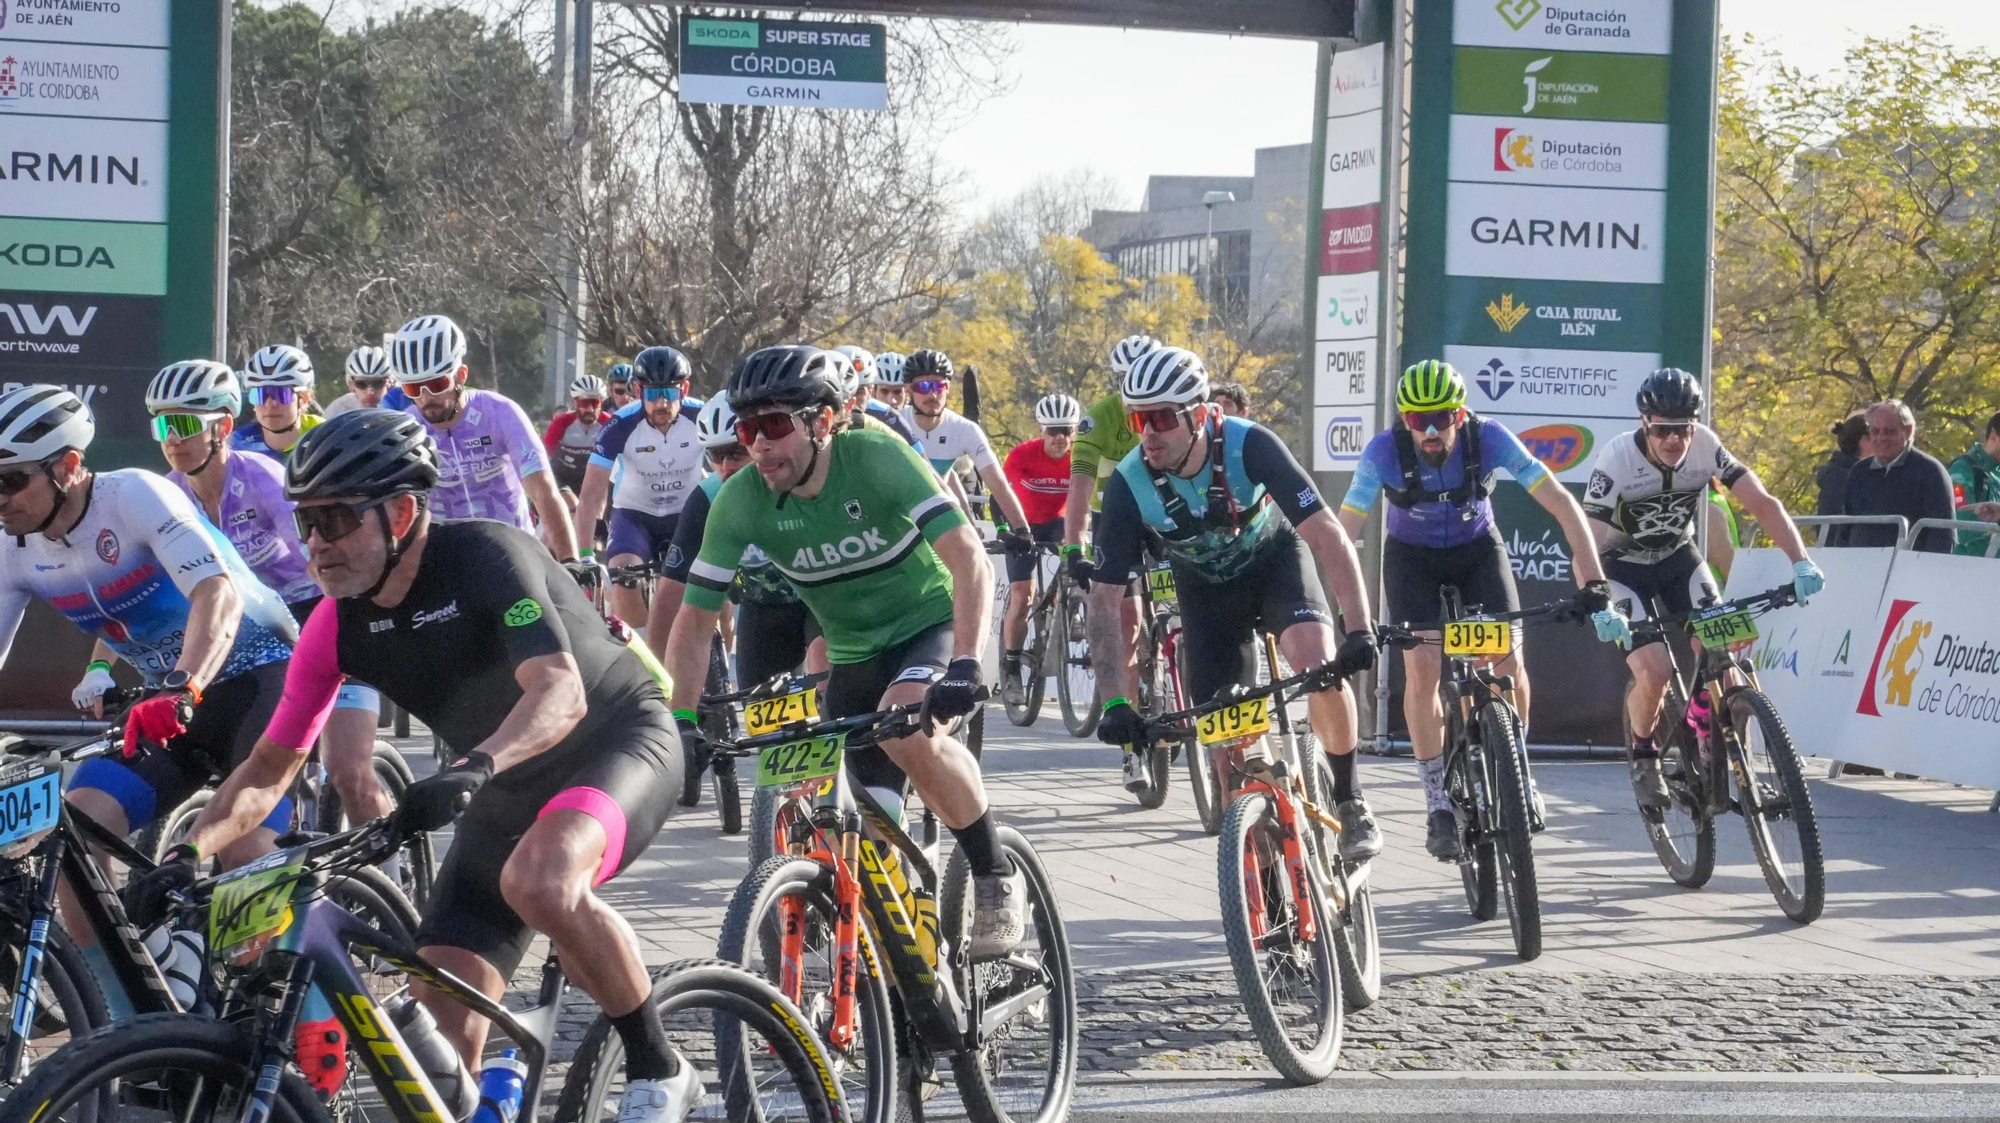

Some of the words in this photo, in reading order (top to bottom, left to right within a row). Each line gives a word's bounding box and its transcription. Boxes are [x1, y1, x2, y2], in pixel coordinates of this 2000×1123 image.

[17, 0, 120, 13] AYUNTAMIENTO
[1546, 7, 1626, 23] Diputación
[16, 13, 34, 24] DE
[38, 13, 73, 26] JAÉN
[766, 29, 817, 44] SUPER
[821, 33, 871, 47] STAGE
[1545, 23, 1562, 35] de
[1565, 23, 1631, 38] Granada
[21, 61, 119, 80] AYUNTAMIENTO
[731, 52, 836, 76] CÓRDOBA
[20, 82, 34, 97] DE
[39, 83, 99, 100] CORDOBA
[747, 85, 820, 100] GARMIN
[1538, 82, 1598, 93] DIPUTACIÓN
[1538, 94, 1550, 102] DE
[1552, 93, 1577, 104] JAÉN
[1542, 140, 1622, 157] Diputación
[0, 151, 138, 186] RMIN
[1330, 149, 1375, 172] GARMIN
[1541, 159, 1558, 169] de
[1563, 158, 1622, 173] Córdoba
[1344, 224, 1372, 245] IMDECO
[1471, 216, 1640, 250] GARMIN
[1536, 306, 1570, 319] CAJA
[1573, 307, 1621, 321] RURAL
[1561, 322, 1595, 336] JAÉN
[1327, 351, 1366, 372] POWER
[1521, 366, 1617, 381] SCIENTIFFIC
[1029, 477, 1056, 485] COSTA
[792, 526, 888, 569] ALBOK
[1450, 624, 1502, 647] 319-1
[1703, 613, 1751, 641] 440-1
[1918, 681, 1942, 713] de
[750, 692, 808, 728] 322-1
[1203, 700, 1264, 736] 319-2
[765, 738, 838, 776] 422-2
[840, 955, 856, 996] FOX
[784, 1017, 839, 1101] SCORPION
